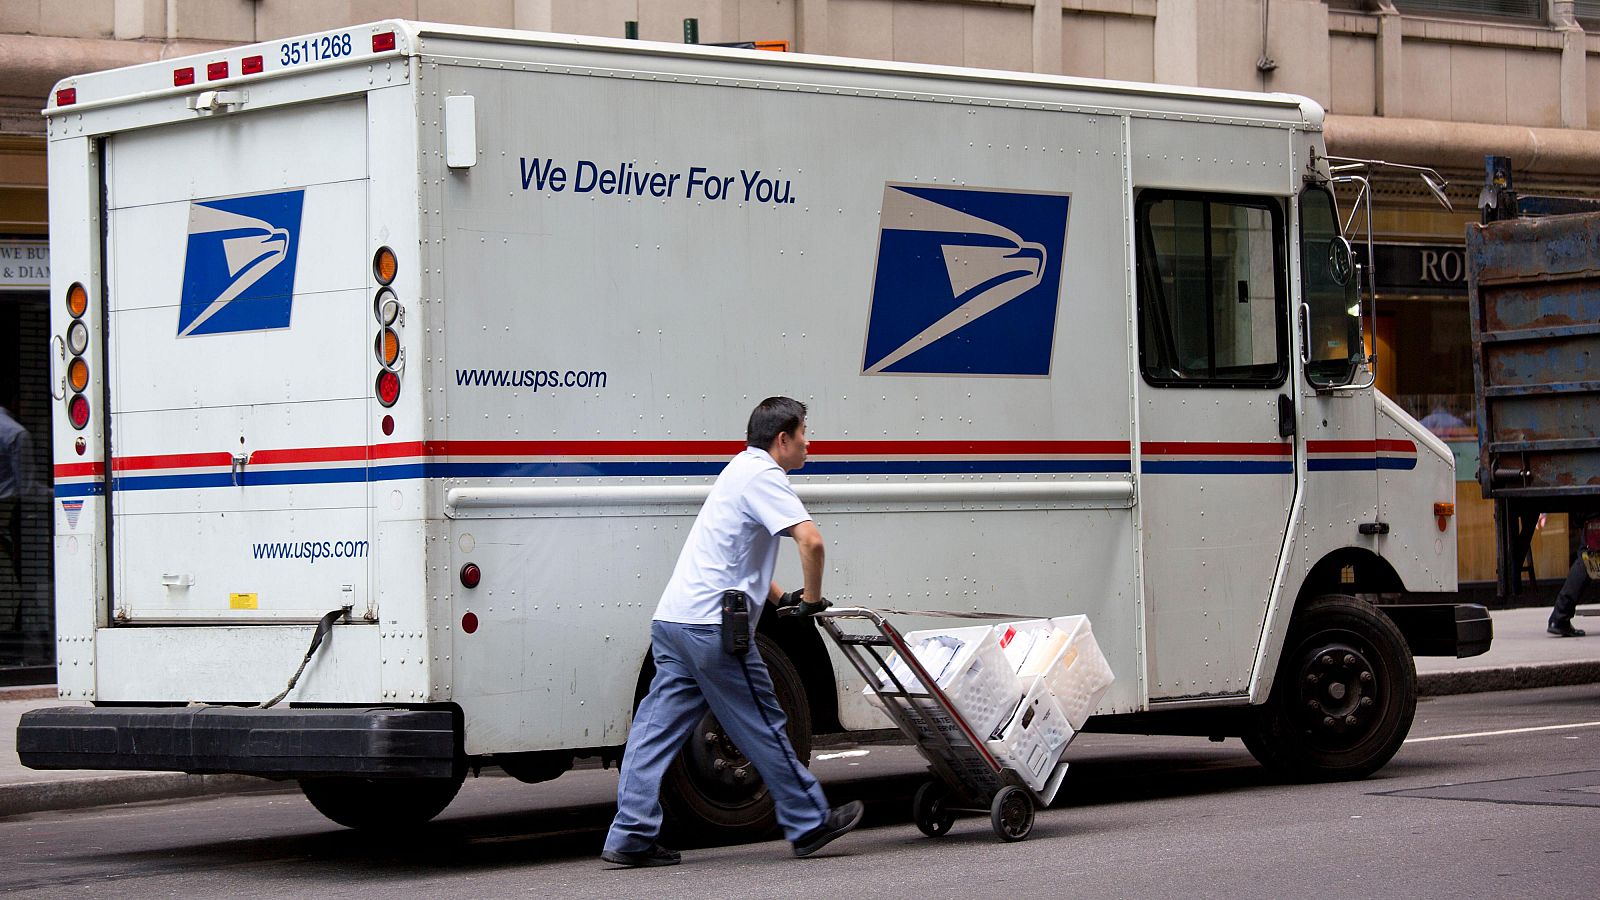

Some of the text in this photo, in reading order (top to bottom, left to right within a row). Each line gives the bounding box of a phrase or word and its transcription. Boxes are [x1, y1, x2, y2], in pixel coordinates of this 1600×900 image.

[280, 33, 352, 66] 3511268
[520, 156, 796, 204] We Deliver For You.
[0, 247, 50, 259] WE BU
[3, 266, 14, 278] &
[456, 369, 607, 392] www.usps.com
[252, 540, 369, 563] www.usps.com
